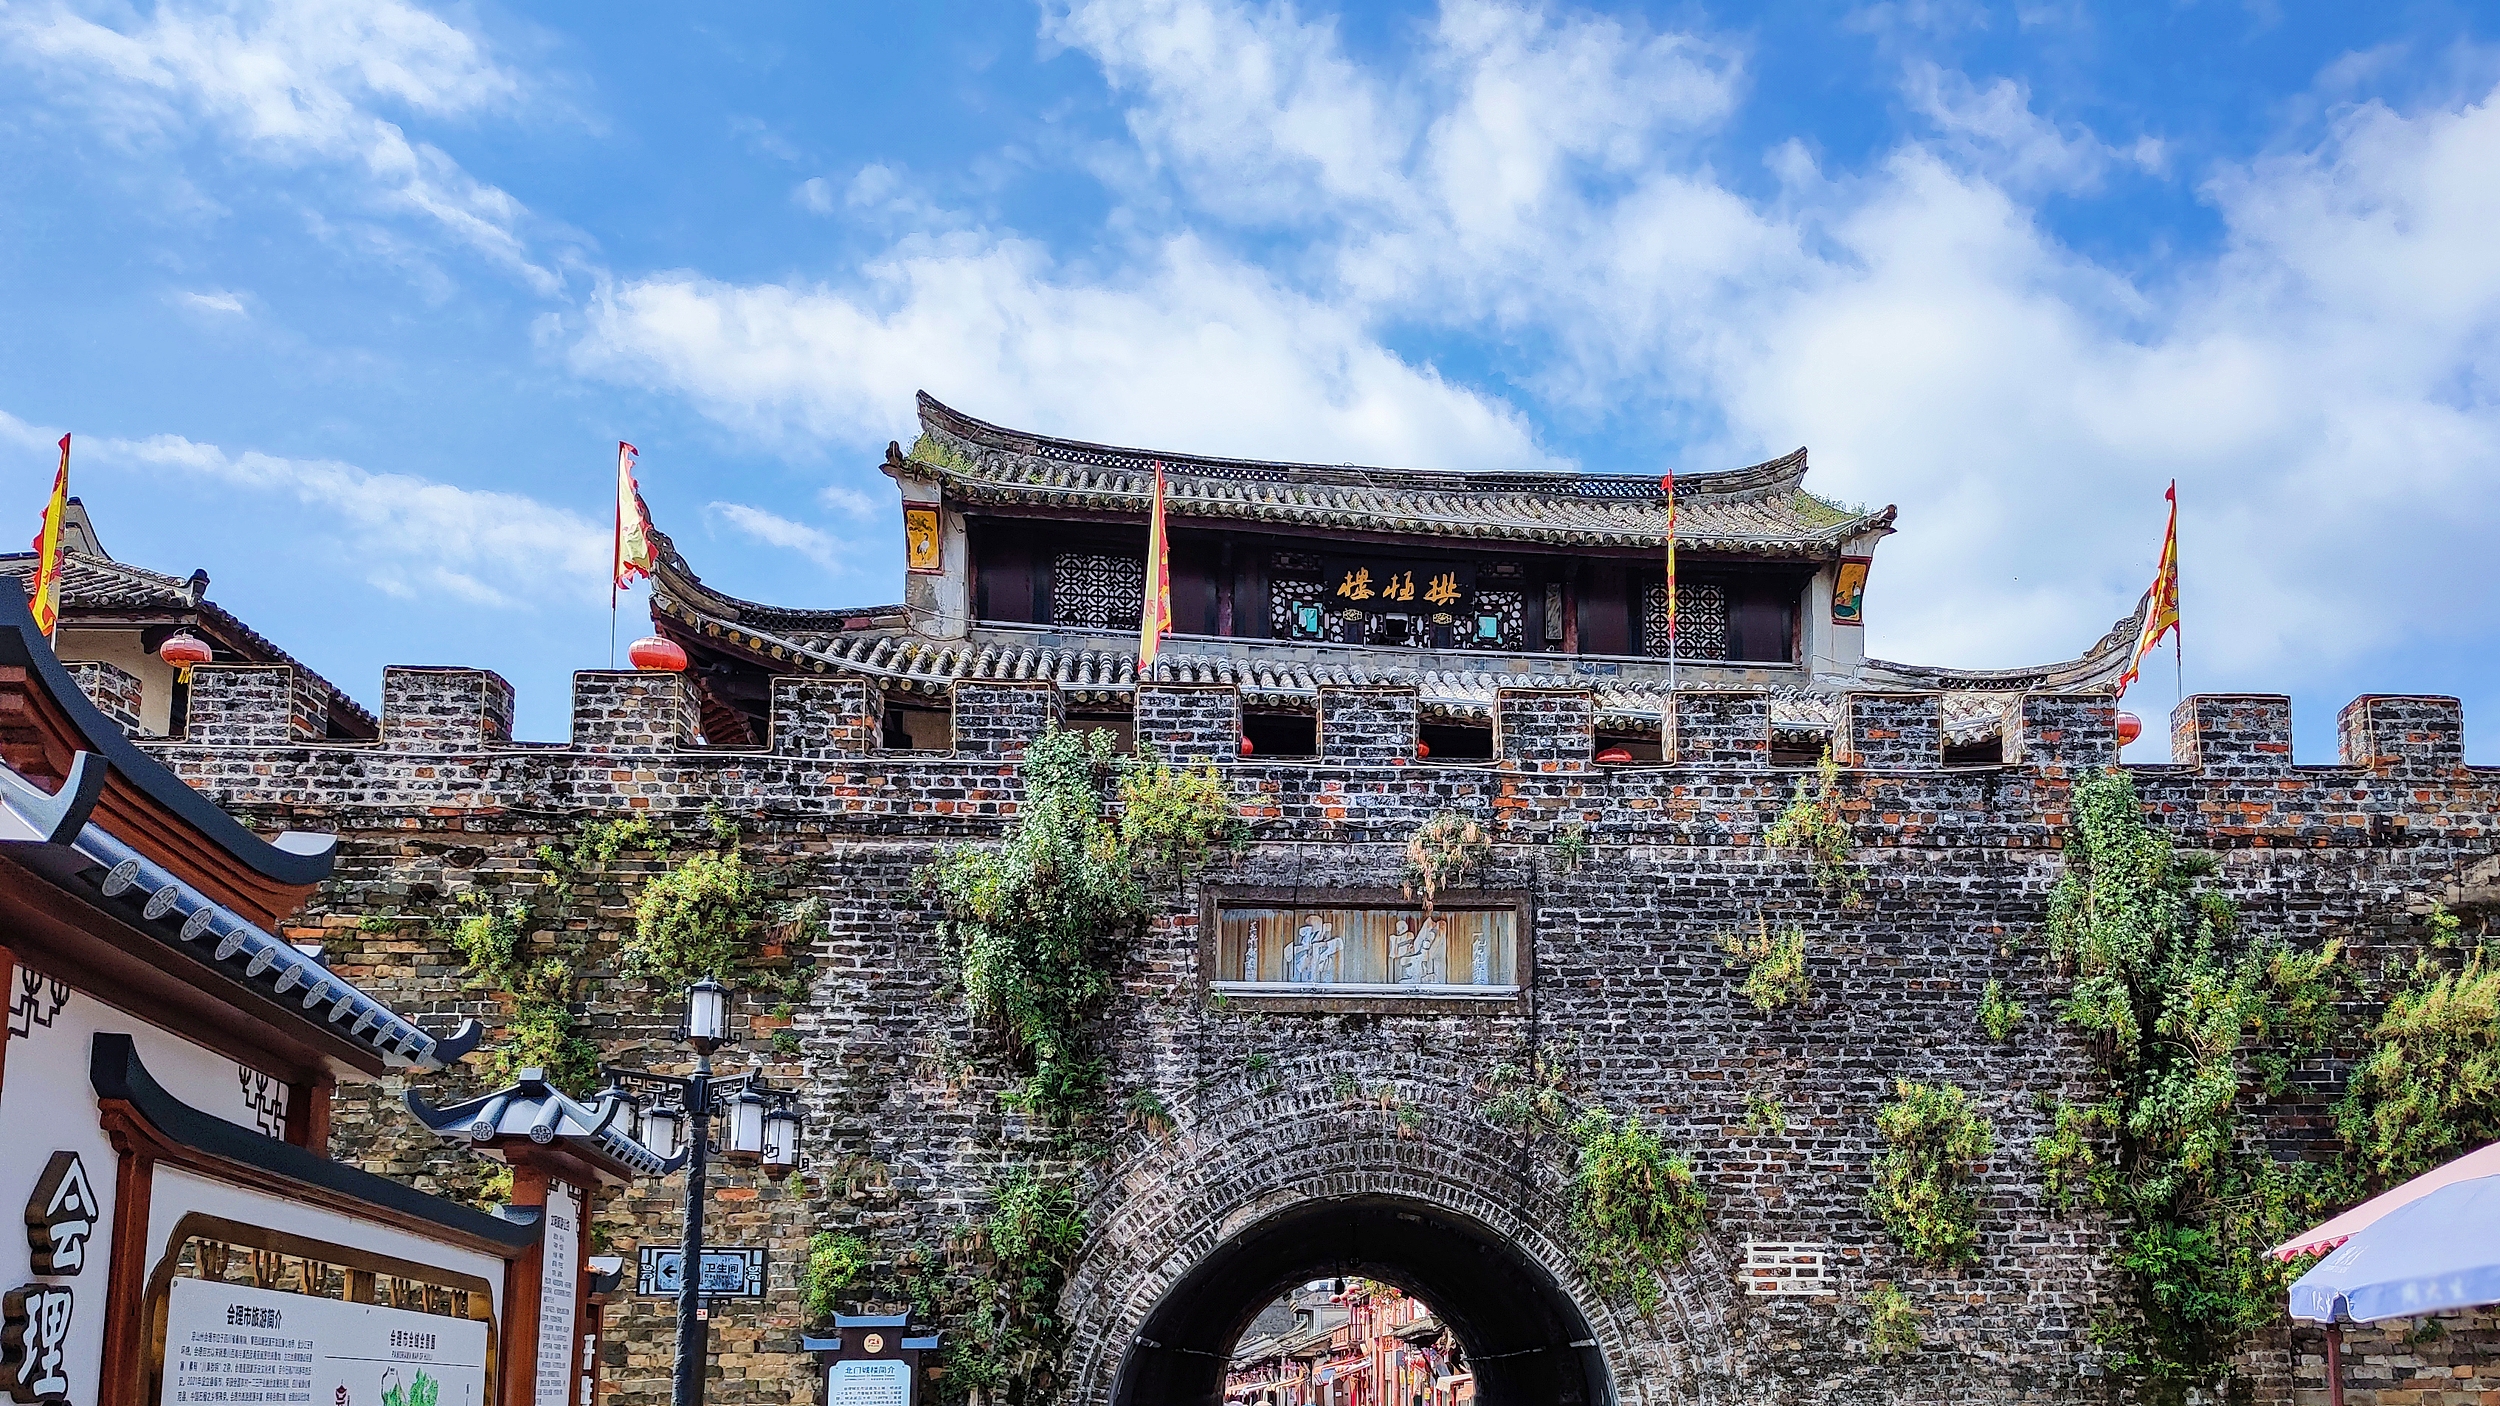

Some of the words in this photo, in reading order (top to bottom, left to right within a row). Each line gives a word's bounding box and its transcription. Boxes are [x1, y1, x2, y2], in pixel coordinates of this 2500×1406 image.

[17, 1157, 97, 1397] 会理
[704, 1263, 739, 1274] 卫生间
[226, 1303, 283, 1330] 会理市旅游简介
[844, 1365, 896, 1374] 北门城楼简介
